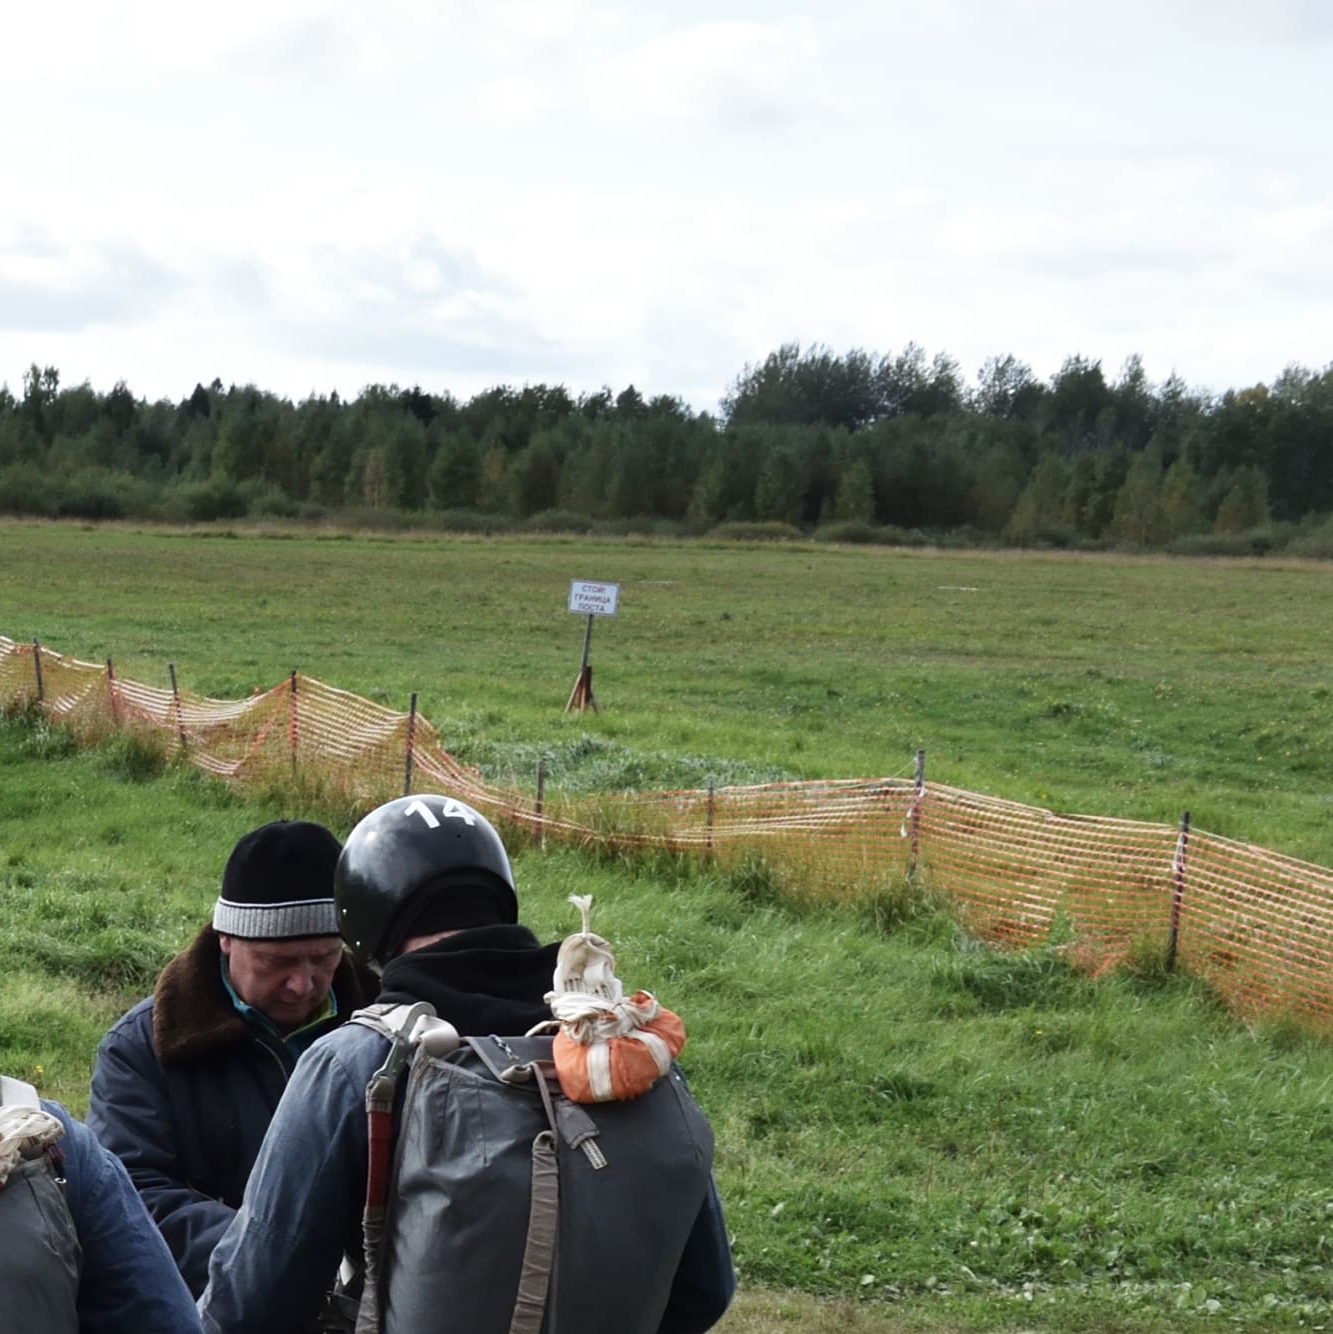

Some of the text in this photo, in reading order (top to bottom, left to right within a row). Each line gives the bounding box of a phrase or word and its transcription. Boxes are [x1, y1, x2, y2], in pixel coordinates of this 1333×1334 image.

[574, 593, 611, 603] ГРАНИЦА
[578, 603, 605, 612] ПОСТА
[404, 799, 476, 828] 14
